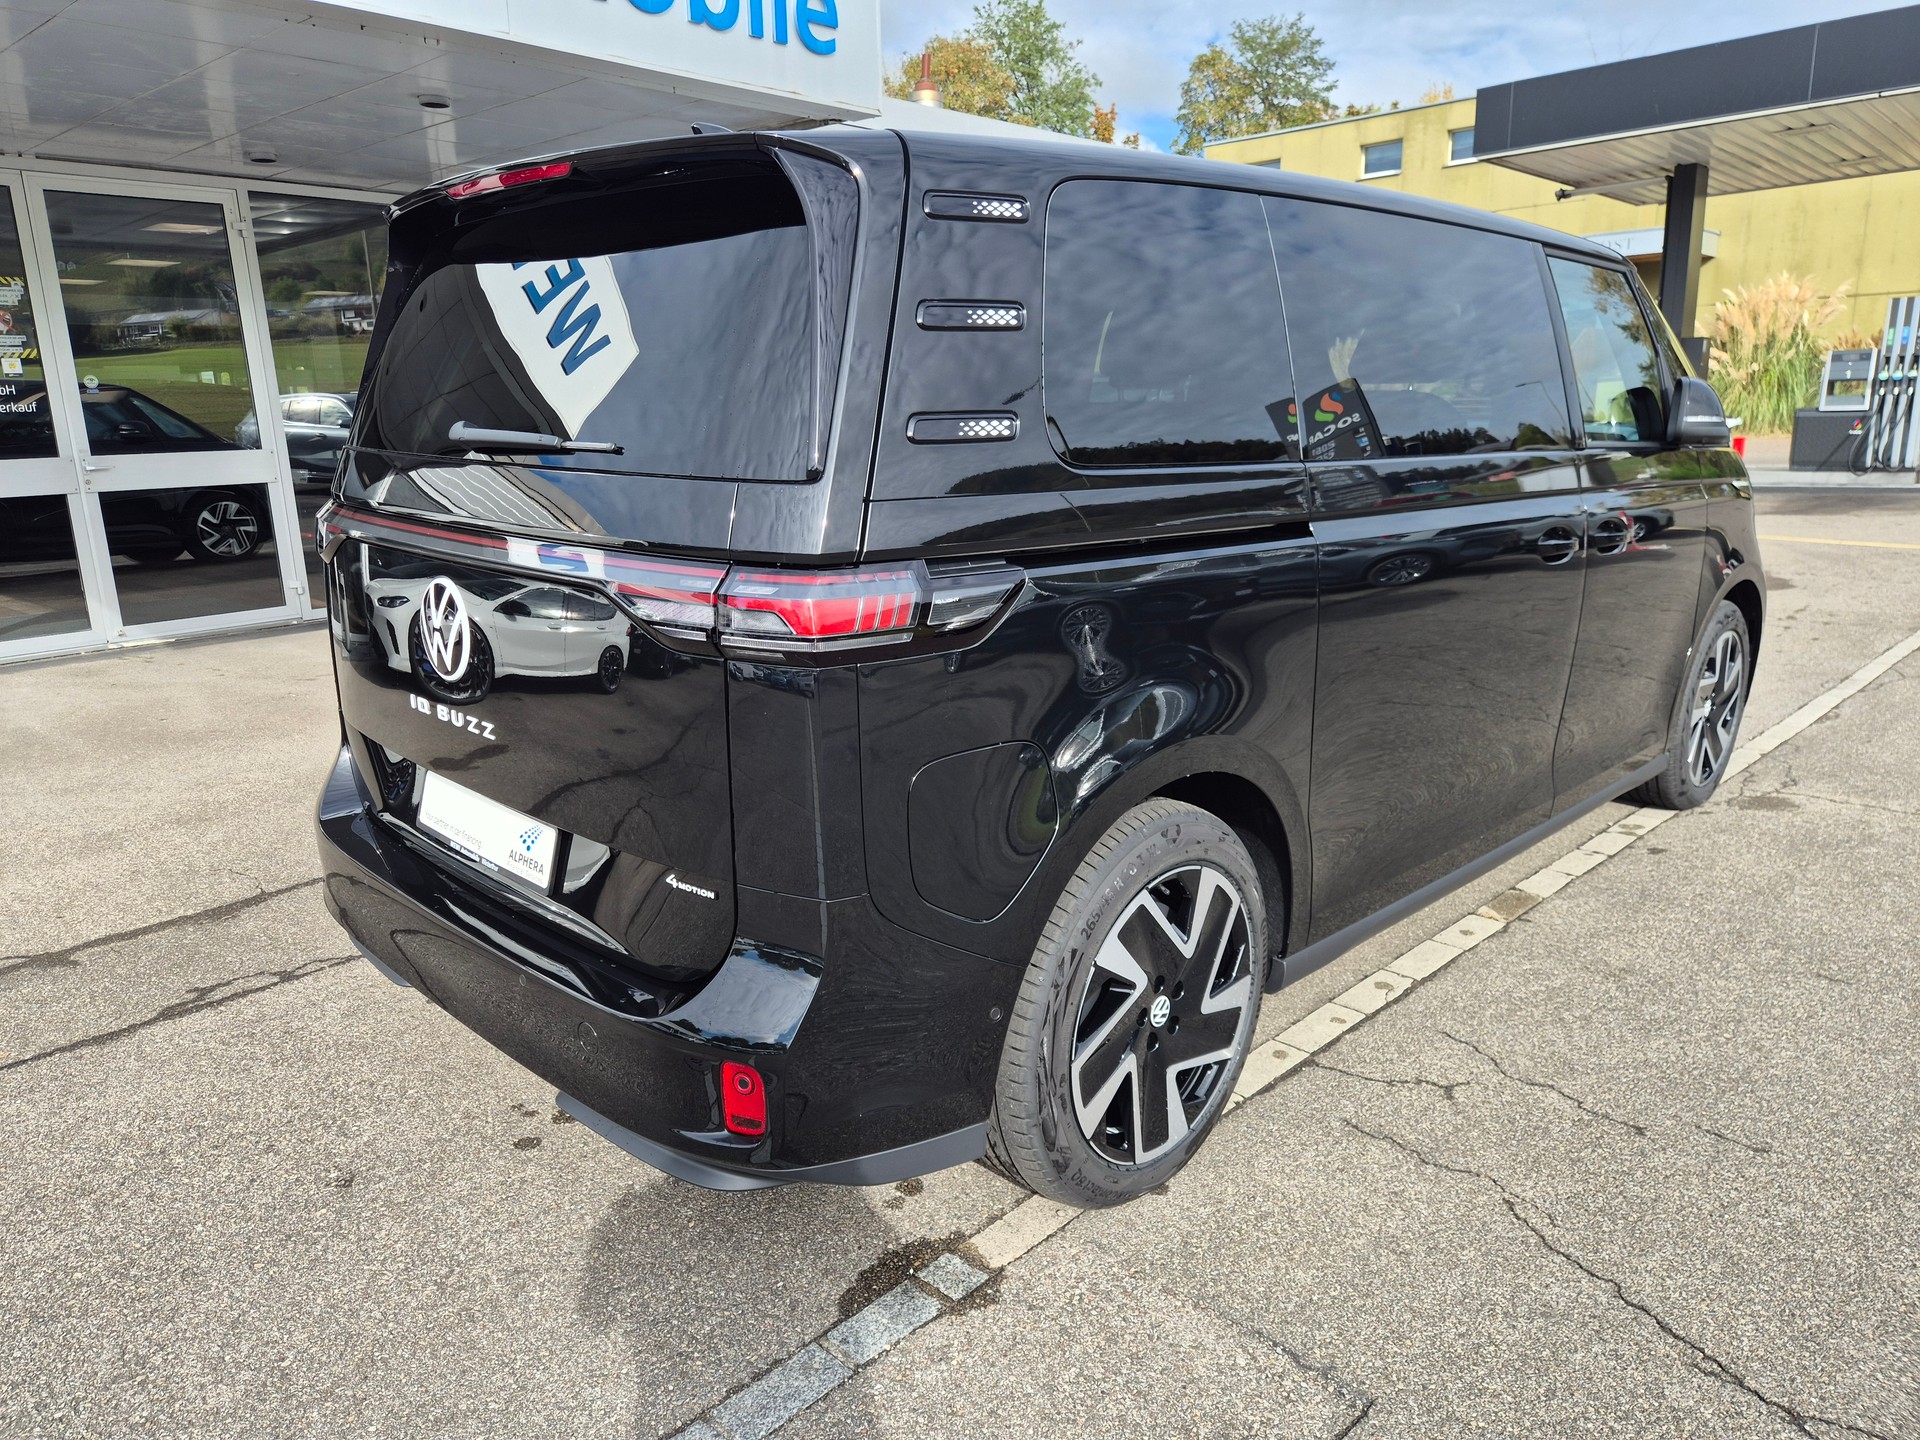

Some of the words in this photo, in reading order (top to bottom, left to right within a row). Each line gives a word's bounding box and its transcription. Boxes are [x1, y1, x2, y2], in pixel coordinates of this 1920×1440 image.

[436, 704, 497, 741] BUZZ
[508, 849, 544, 876] ALPHERA
[665, 874, 715, 900] 4MOTION
